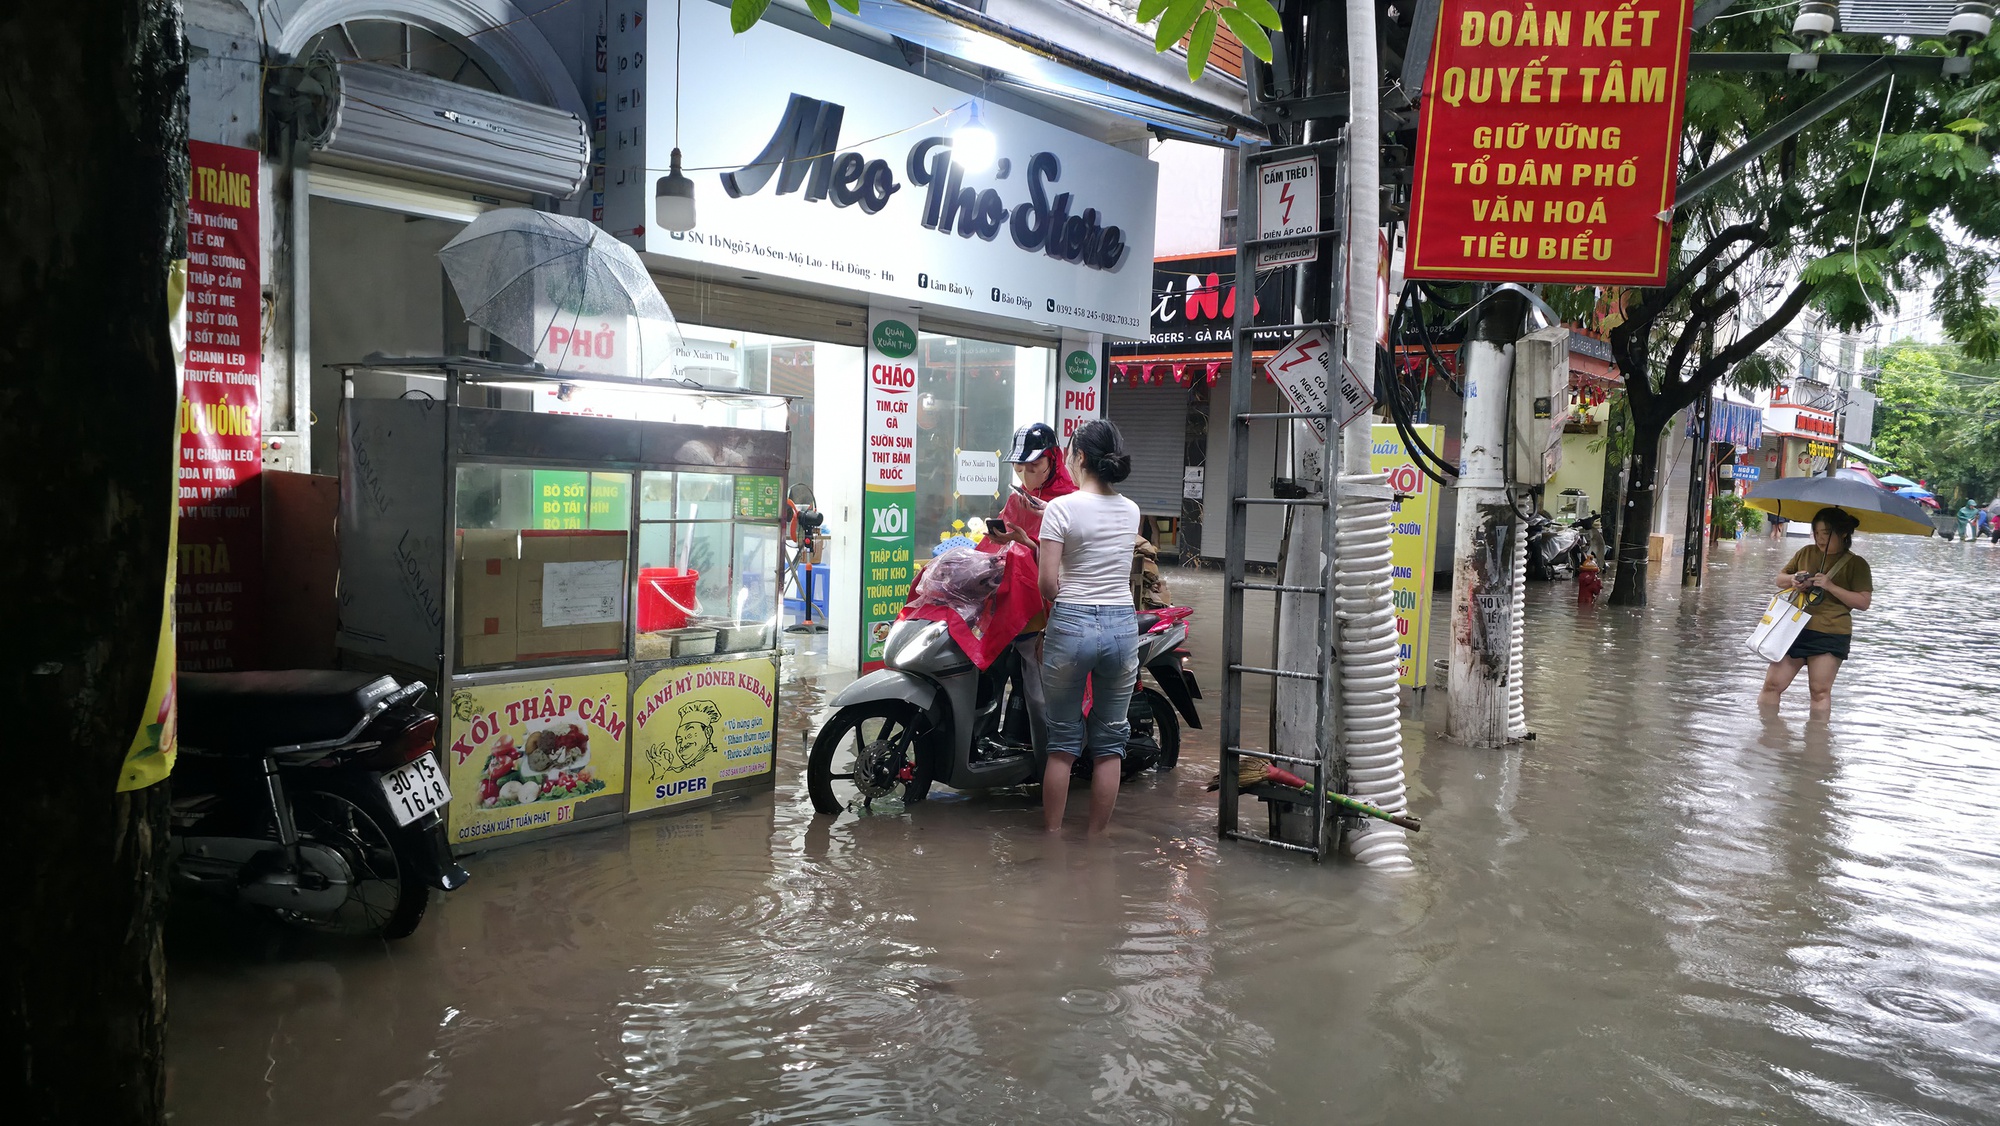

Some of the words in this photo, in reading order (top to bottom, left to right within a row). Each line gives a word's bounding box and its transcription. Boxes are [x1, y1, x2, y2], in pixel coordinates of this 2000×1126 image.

[1460, 2, 1571, 46] ĐOÀN
[1582, 0, 1660, 46] KẾT
[1441, 56, 1568, 107] QUYẾT
[1579, 60, 1667, 103] TÂM
[1472, 122, 1530, 149] GIỮ
[1535, 122, 1621, 149] VỮNG
[1264, 169, 1283, 184] CẤM
[1285, 166, 1307, 181] TRÈO
[1451, 154, 1491, 185] TỔ
[1496, 159, 1563, 185] DÂN
[1571, 156, 1639, 187] PHỐ
[198, 163, 251, 209] TRÁNG
[720, 93, 900, 215] Meo
[1010, 152, 1128, 272] Store
[1472, 195, 1534, 222] VĂN
[1543, 197, 1607, 224] HOÁ
[204, 212, 238, 230] THỐNG
[1283, 227, 1294, 236] ÁP
[1296, 225, 1313, 234] CAO
[206, 234, 225, 248] CAY
[1461, 231, 1529, 259] TIÊU
[1537, 229, 1612, 260] BIỂU
[211, 253, 246, 271] SƯƠNG
[688, 231, 704, 244] SN
[752, 244, 766, 256] Ao
[831, 259, 844, 271] Hà
[848, 262, 871, 279] Đông
[881, 271, 894, 281] Hn
[1264, 252, 1284, 261] CHẾT
[189, 270, 216, 288] THẬP
[218, 271, 242, 289] CẨM
[930, 280, 947, 291] Lâm
[948, 282, 962, 294] Bảo
[964, 286, 975, 298] Vy
[197, 290, 217, 306] SỐT
[220, 295, 236, 308] ME
[1001, 292, 1014, 304] Bảo
[1016, 295, 1033, 309] Điệp
[195, 310, 215, 326] SỐT
[1056, 303, 1072, 314] 0392
[1073, 307, 1086, 317] 458
[194, 331, 214, 346] SỐT
[216, 331, 240, 347] XOÀI
[549, 322, 615, 360] PHỞ
[1195, 328, 1214, 342] GÀ
[1216, 326, 1232, 340] RÁ
[189, 349, 225, 364] CHANH
[226, 352, 246, 366] LEO
[693, 349, 713, 360] Xuân
[715, 351, 729, 361] Thu
[184, 367, 222, 384] TRUYỀN
[225, 369, 258, 386] THỐNG
[872, 363, 915, 388] CHÁO
[1289, 384, 1307, 405] CHẾT
[1300, 378, 1319, 401] NGUY
[1065, 387, 1096, 412] PHỞ
[205, 393, 252, 437] UỐNG
[886, 416, 898, 430] GÀ
[870, 434, 894, 448] SƯỜN
[896, 437, 913, 451] SỤN
[183, 448, 194, 462] VỊ
[197, 448, 232, 461] CHANH
[234, 449, 254, 462] LEO
[872, 451, 890, 465] THỊT
[202, 468, 213, 482] VỊ
[880, 465, 903, 480] RUỐC
[201, 487, 212, 501] VỊ
[214, 485, 237, 499] XOÀI
[543, 483, 560, 497] BÒ
[563, 482, 585, 497] SỐT
[200, 505, 222, 518] VIỆT
[543, 500, 560, 513] BÒ
[563, 500, 580, 513] TÁI
[871, 502, 908, 533] XÔI
[178, 536, 231, 575] TRÀ
[870, 548, 891, 564] THẬP
[892, 545, 909, 562] CẨM
[872, 567, 888, 582] THỊT
[890, 567, 906, 580] KHO
[866, 583, 892, 599] TRỨNG
[894, 583, 911, 596] KHO
[873, 602, 887, 616] GIÒ
[636, 683, 673, 729] BÁNH
[675, 671, 693, 696] MỲ
[696, 667, 735, 689] DÖNER
[738, 673, 773, 708] KEBAB
[451, 711, 500, 765] XÔI
[505, 688, 573, 726] THẬP
[578, 694, 626, 741] CẨM
[655, 777, 707, 800] SUPER
[402, 781, 444, 817] 1648
[459, 828, 470, 839] CƠ
[471, 821, 481, 837] SỞ
[482, 822, 495, 835] SẢN
[496, 818, 514, 831] XUẤT
[515, 812, 532, 827] TUẤN
[533, 811, 551, 825] PHÁT
